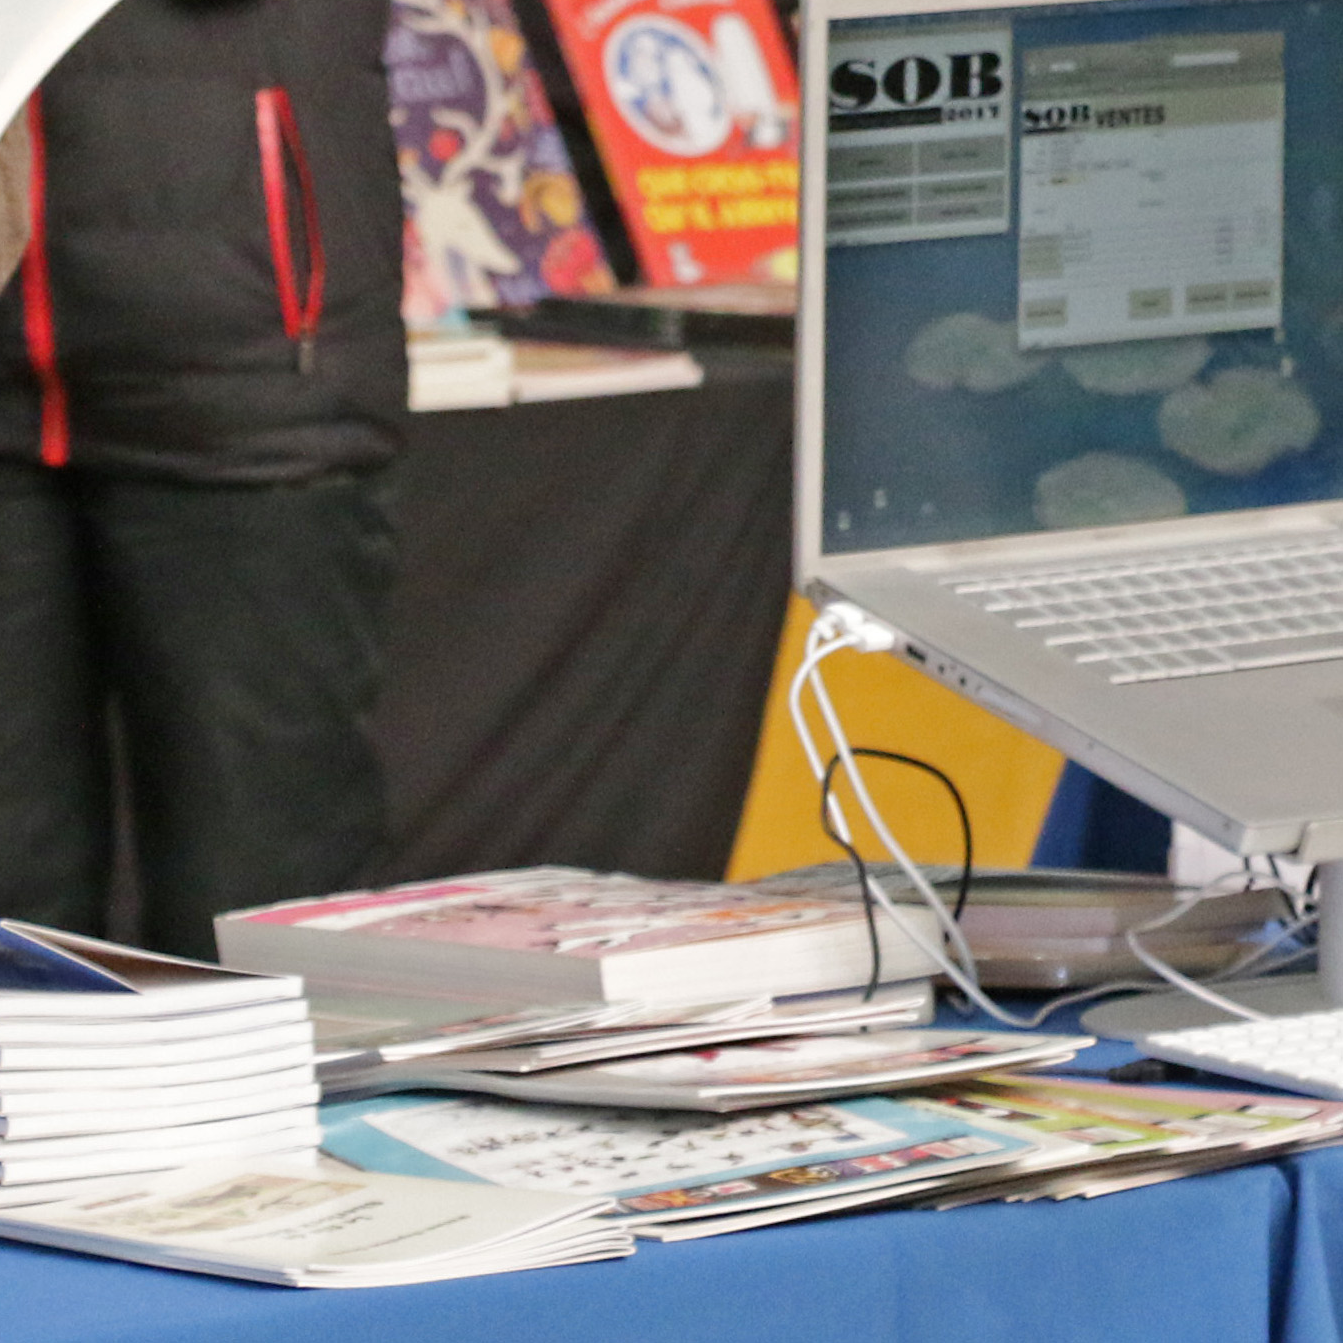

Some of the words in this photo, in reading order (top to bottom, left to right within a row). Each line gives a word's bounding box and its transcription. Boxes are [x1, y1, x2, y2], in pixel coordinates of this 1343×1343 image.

[829, 52, 1002, 111] SOB
[944, 104, 1000, 124] 2017
[1024, 104, 1090, 128] SOB
[1094, 104, 1165, 129] VENTES
